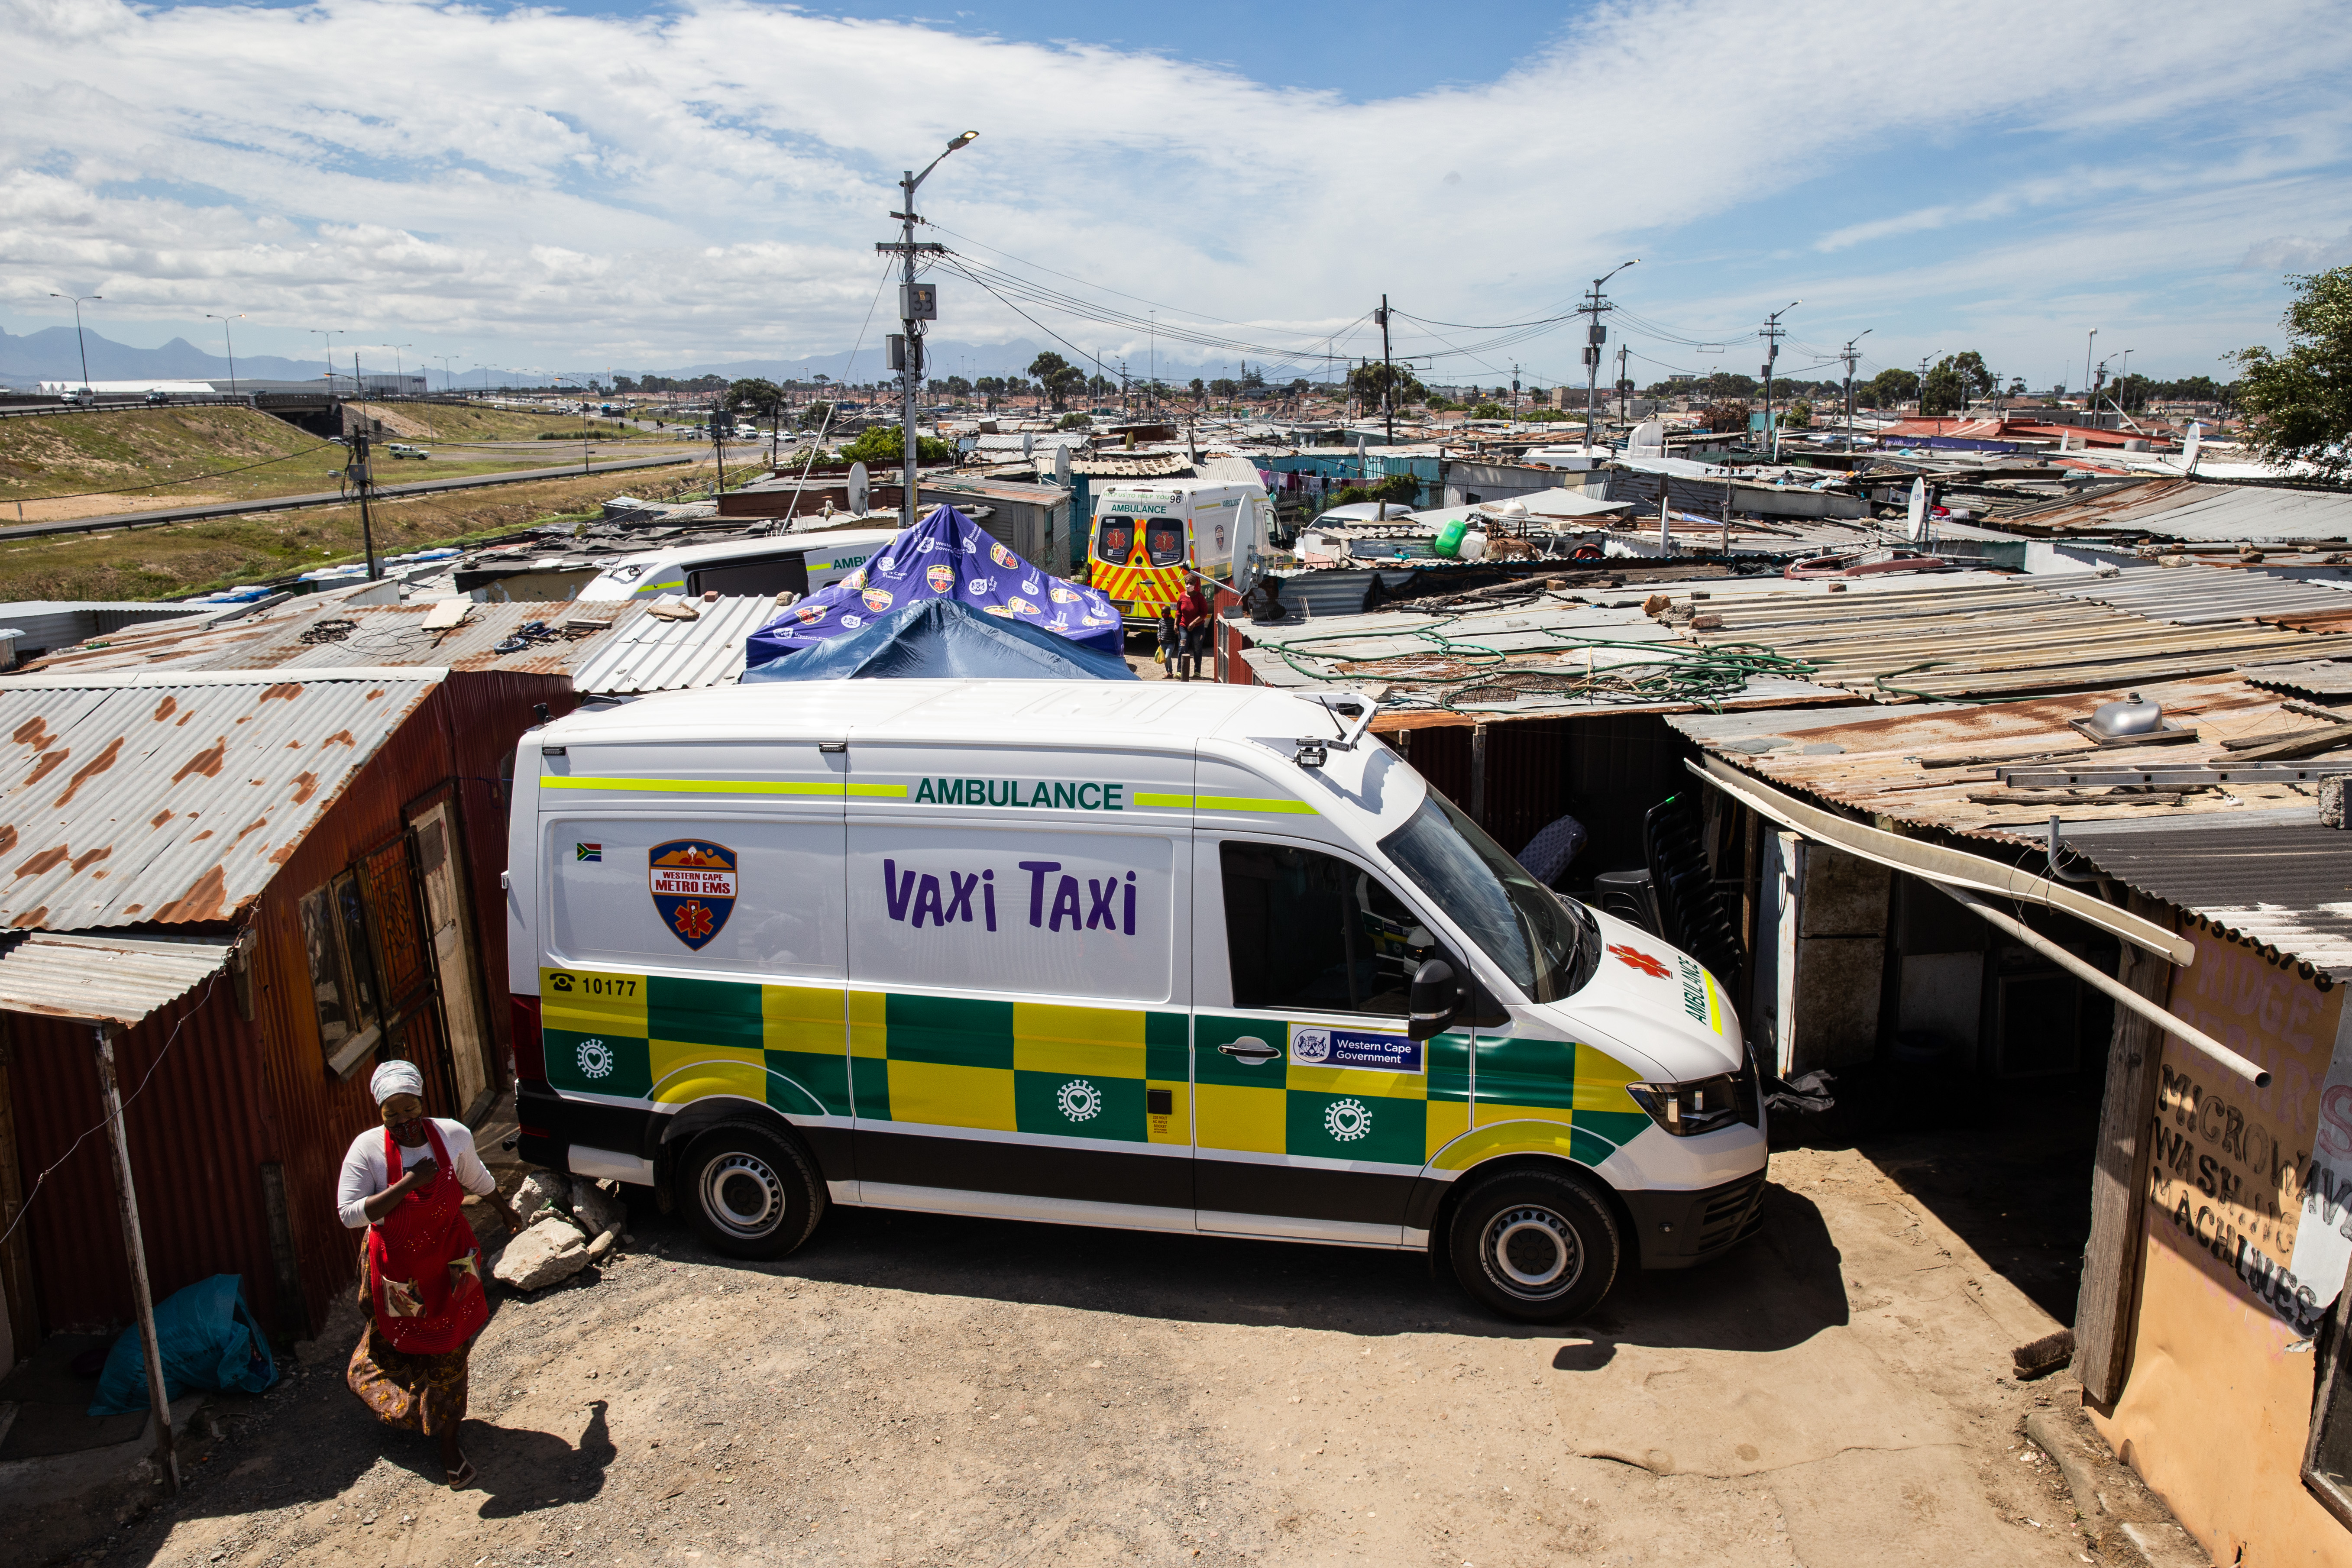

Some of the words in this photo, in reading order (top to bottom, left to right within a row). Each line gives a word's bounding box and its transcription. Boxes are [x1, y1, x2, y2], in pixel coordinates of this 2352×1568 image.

[912, 291, 933, 312] 33
[1170, 495, 1181, 504] 96
[1111, 504, 1167, 514] AMBULANCE
[1204, 587, 1211, 599] 96
[915, 778, 1123, 810] AMBULANCE
[663, 871, 696, 881] WESTERN
[702, 873, 723, 881] CAPE
[655, 879, 698, 893] METRO
[702, 882, 730, 895] EMS
[583, 977, 636, 997] 10177
[1678, 955, 1707, 1026] AMBULANCE
[1337, 1039, 1381, 1051] Western
[1384, 1043, 1411, 1054] Cape
[1336, 1050, 1401, 1064] Government
[2154, 1116, 2299, 1254] WASHING
[2150, 1166, 2317, 1336] MACHINES
